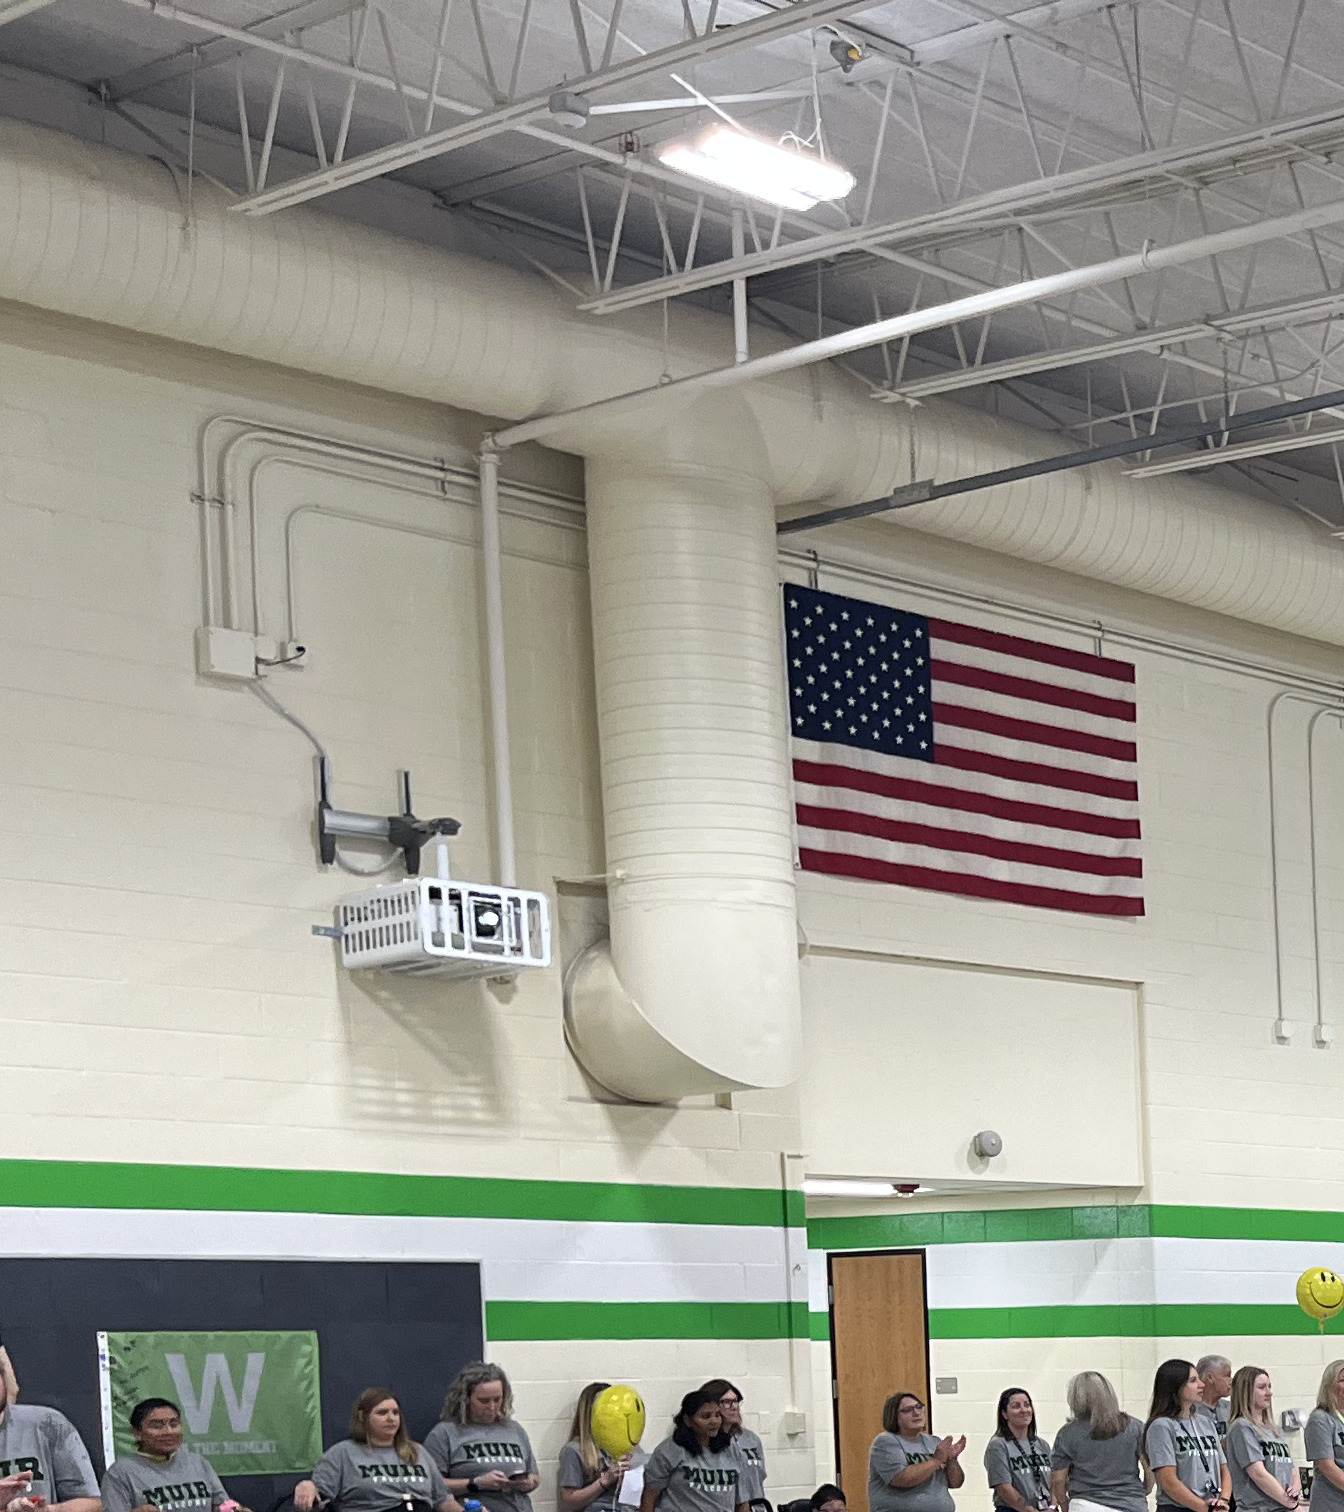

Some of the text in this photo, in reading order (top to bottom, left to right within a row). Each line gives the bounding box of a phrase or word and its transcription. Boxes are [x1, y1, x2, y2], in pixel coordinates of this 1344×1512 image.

[165, 1352, 266, 1434] W
[462, 1442, 524, 1459] MUIR
[358, 1464, 429, 1478] MUIR
[683, 1465, 739, 1485] MUIR
[142, 1480, 212, 1505] MUIR
